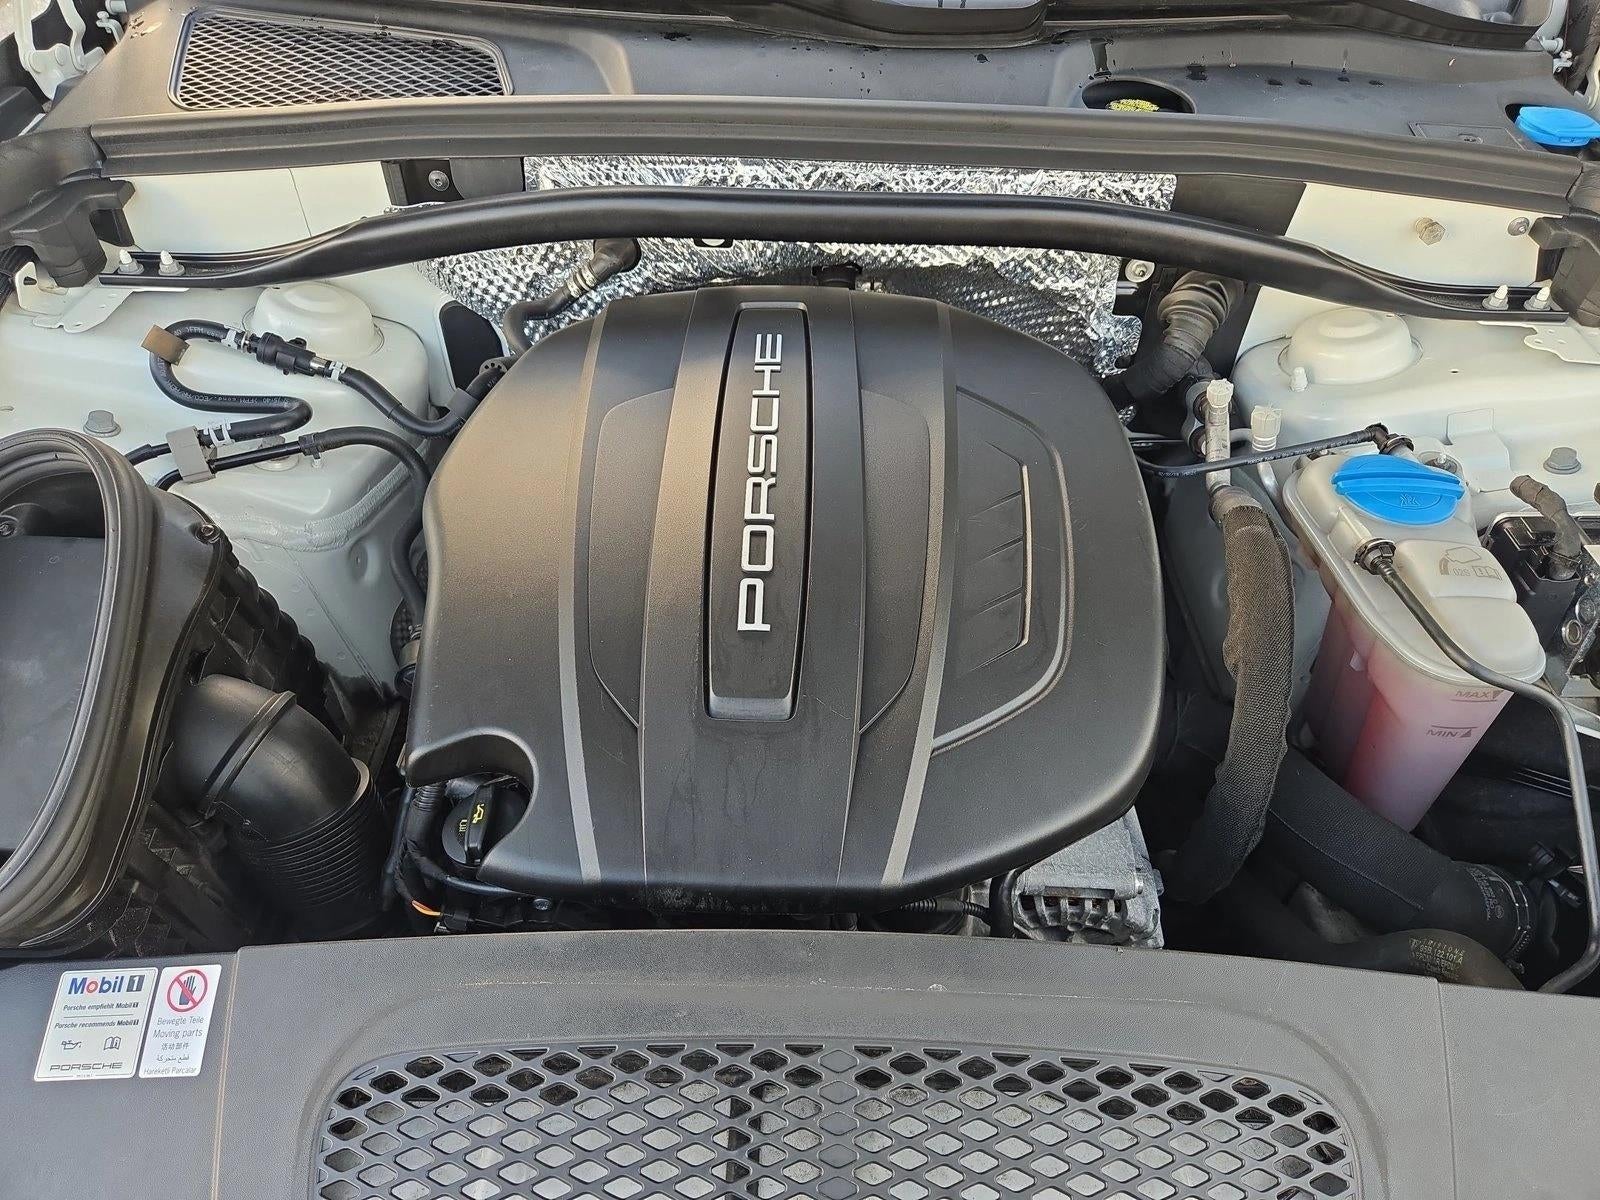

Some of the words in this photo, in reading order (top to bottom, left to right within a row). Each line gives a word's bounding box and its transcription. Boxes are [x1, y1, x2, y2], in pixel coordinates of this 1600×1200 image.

[737, 333, 783, 632] PORSCHE
[1455, 690, 1490, 699] MAX
[1426, 729, 1458, 738] MIN
[68, 975, 125, 995] Mobil
[63, 1003, 86, 1011] Porsche
[88, 1002, 114, 1012] empfiehlt
[54, 1021, 78, 1029] Porsche
[78, 1020, 116, 1029] recommends
[156, 1016, 187, 1026] Bewegte
[190, 1015, 204, 1024] Teile
[152, 1029, 181, 1039] Moving
[182, 1028, 203, 1039] parts
[49, 1062, 123, 1072] PORSCHE
